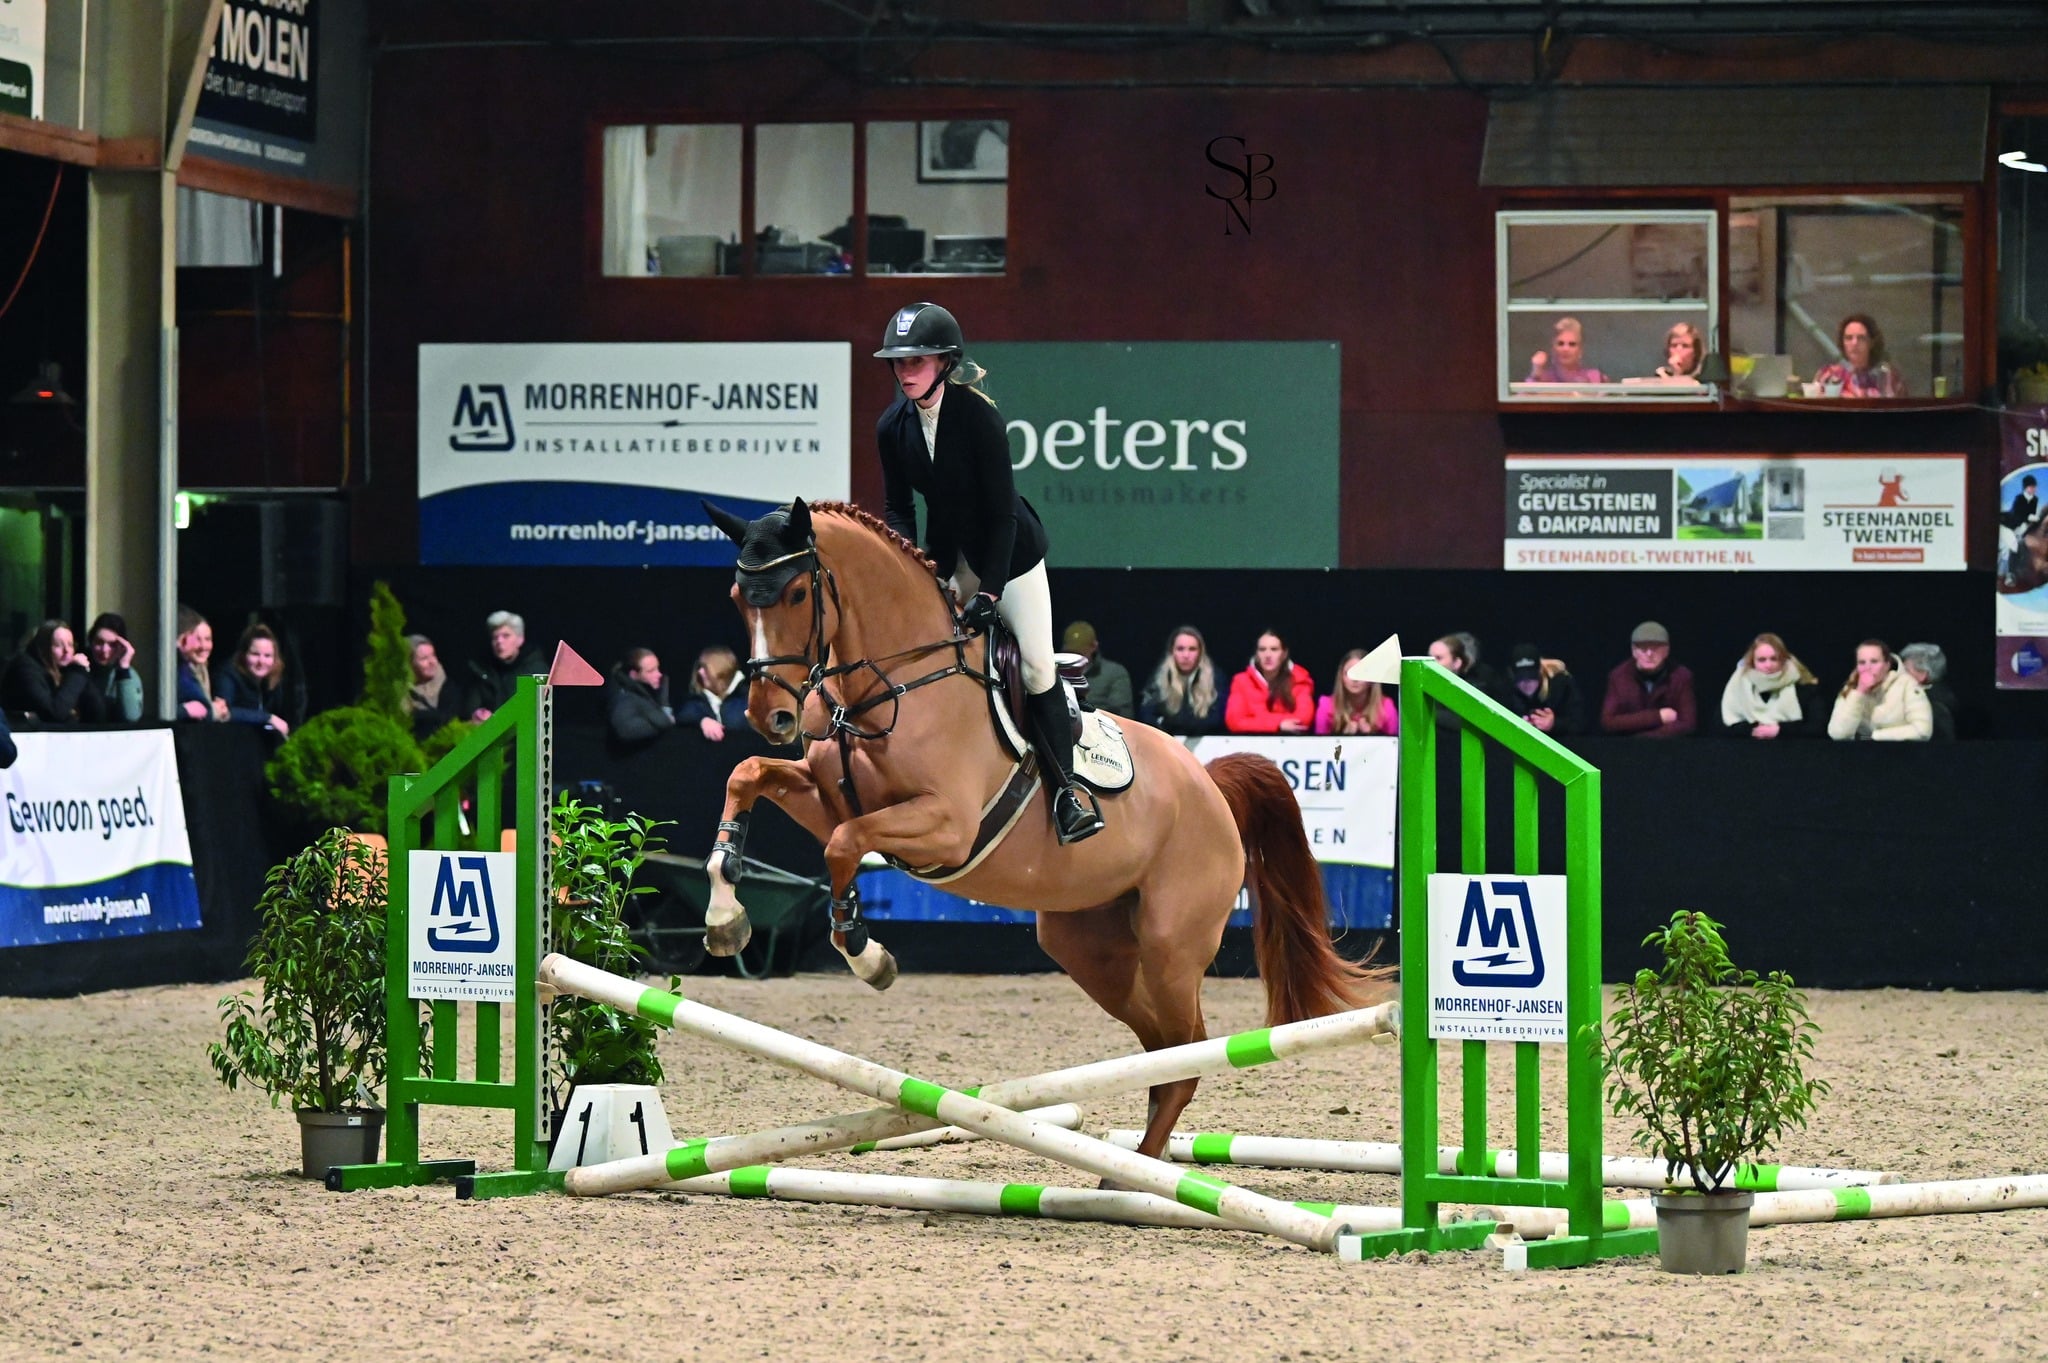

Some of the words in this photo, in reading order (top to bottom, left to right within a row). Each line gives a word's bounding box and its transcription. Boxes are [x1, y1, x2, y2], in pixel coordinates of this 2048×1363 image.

[222, 2, 309, 82] MOLEN
[525, 383, 819, 411] MORRENHOF-JANSEN
[525, 439, 820, 455] INSTALLATIEBEDRIJVEN
[1519, 473, 1590, 491] Specialist
[1592, 473, 1607, 489] in
[1043, 480, 1248, 504] thuismakers
[1518, 493, 1657, 511] GEVELSTENEN
[1518, 515, 1533, 533] &
[1538, 515, 1660, 533] DAKPANNEN
[1823, 512, 1954, 527] STEENHANDEL
[510, 520, 731, 545] morrenhof-jansen.
[1843, 529, 1934, 543] TWENTHE
[1517, 550, 1755, 564] STEENHANDEL-TWENTHE.NL
[1282, 760, 1346, 791] SEN
[6, 792, 93, 833] Gewoon
[98, 786, 154, 840] goed.
[44, 892, 151, 924] morrenhof-jansen.nl
[413, 961, 514, 977] MORRENHOF-JANSEN
[413, 986, 515, 997] INSTALLATIEBEDRIJVEN
[1435, 997, 1563, 1014] MORRENHOF-JANSEN
[1435, 1024, 1564, 1036] INSTALLATIEBEDRIJVEN
[579, 1102, 593, 1167] 1
[630, 1101, 649, 1156] 1
